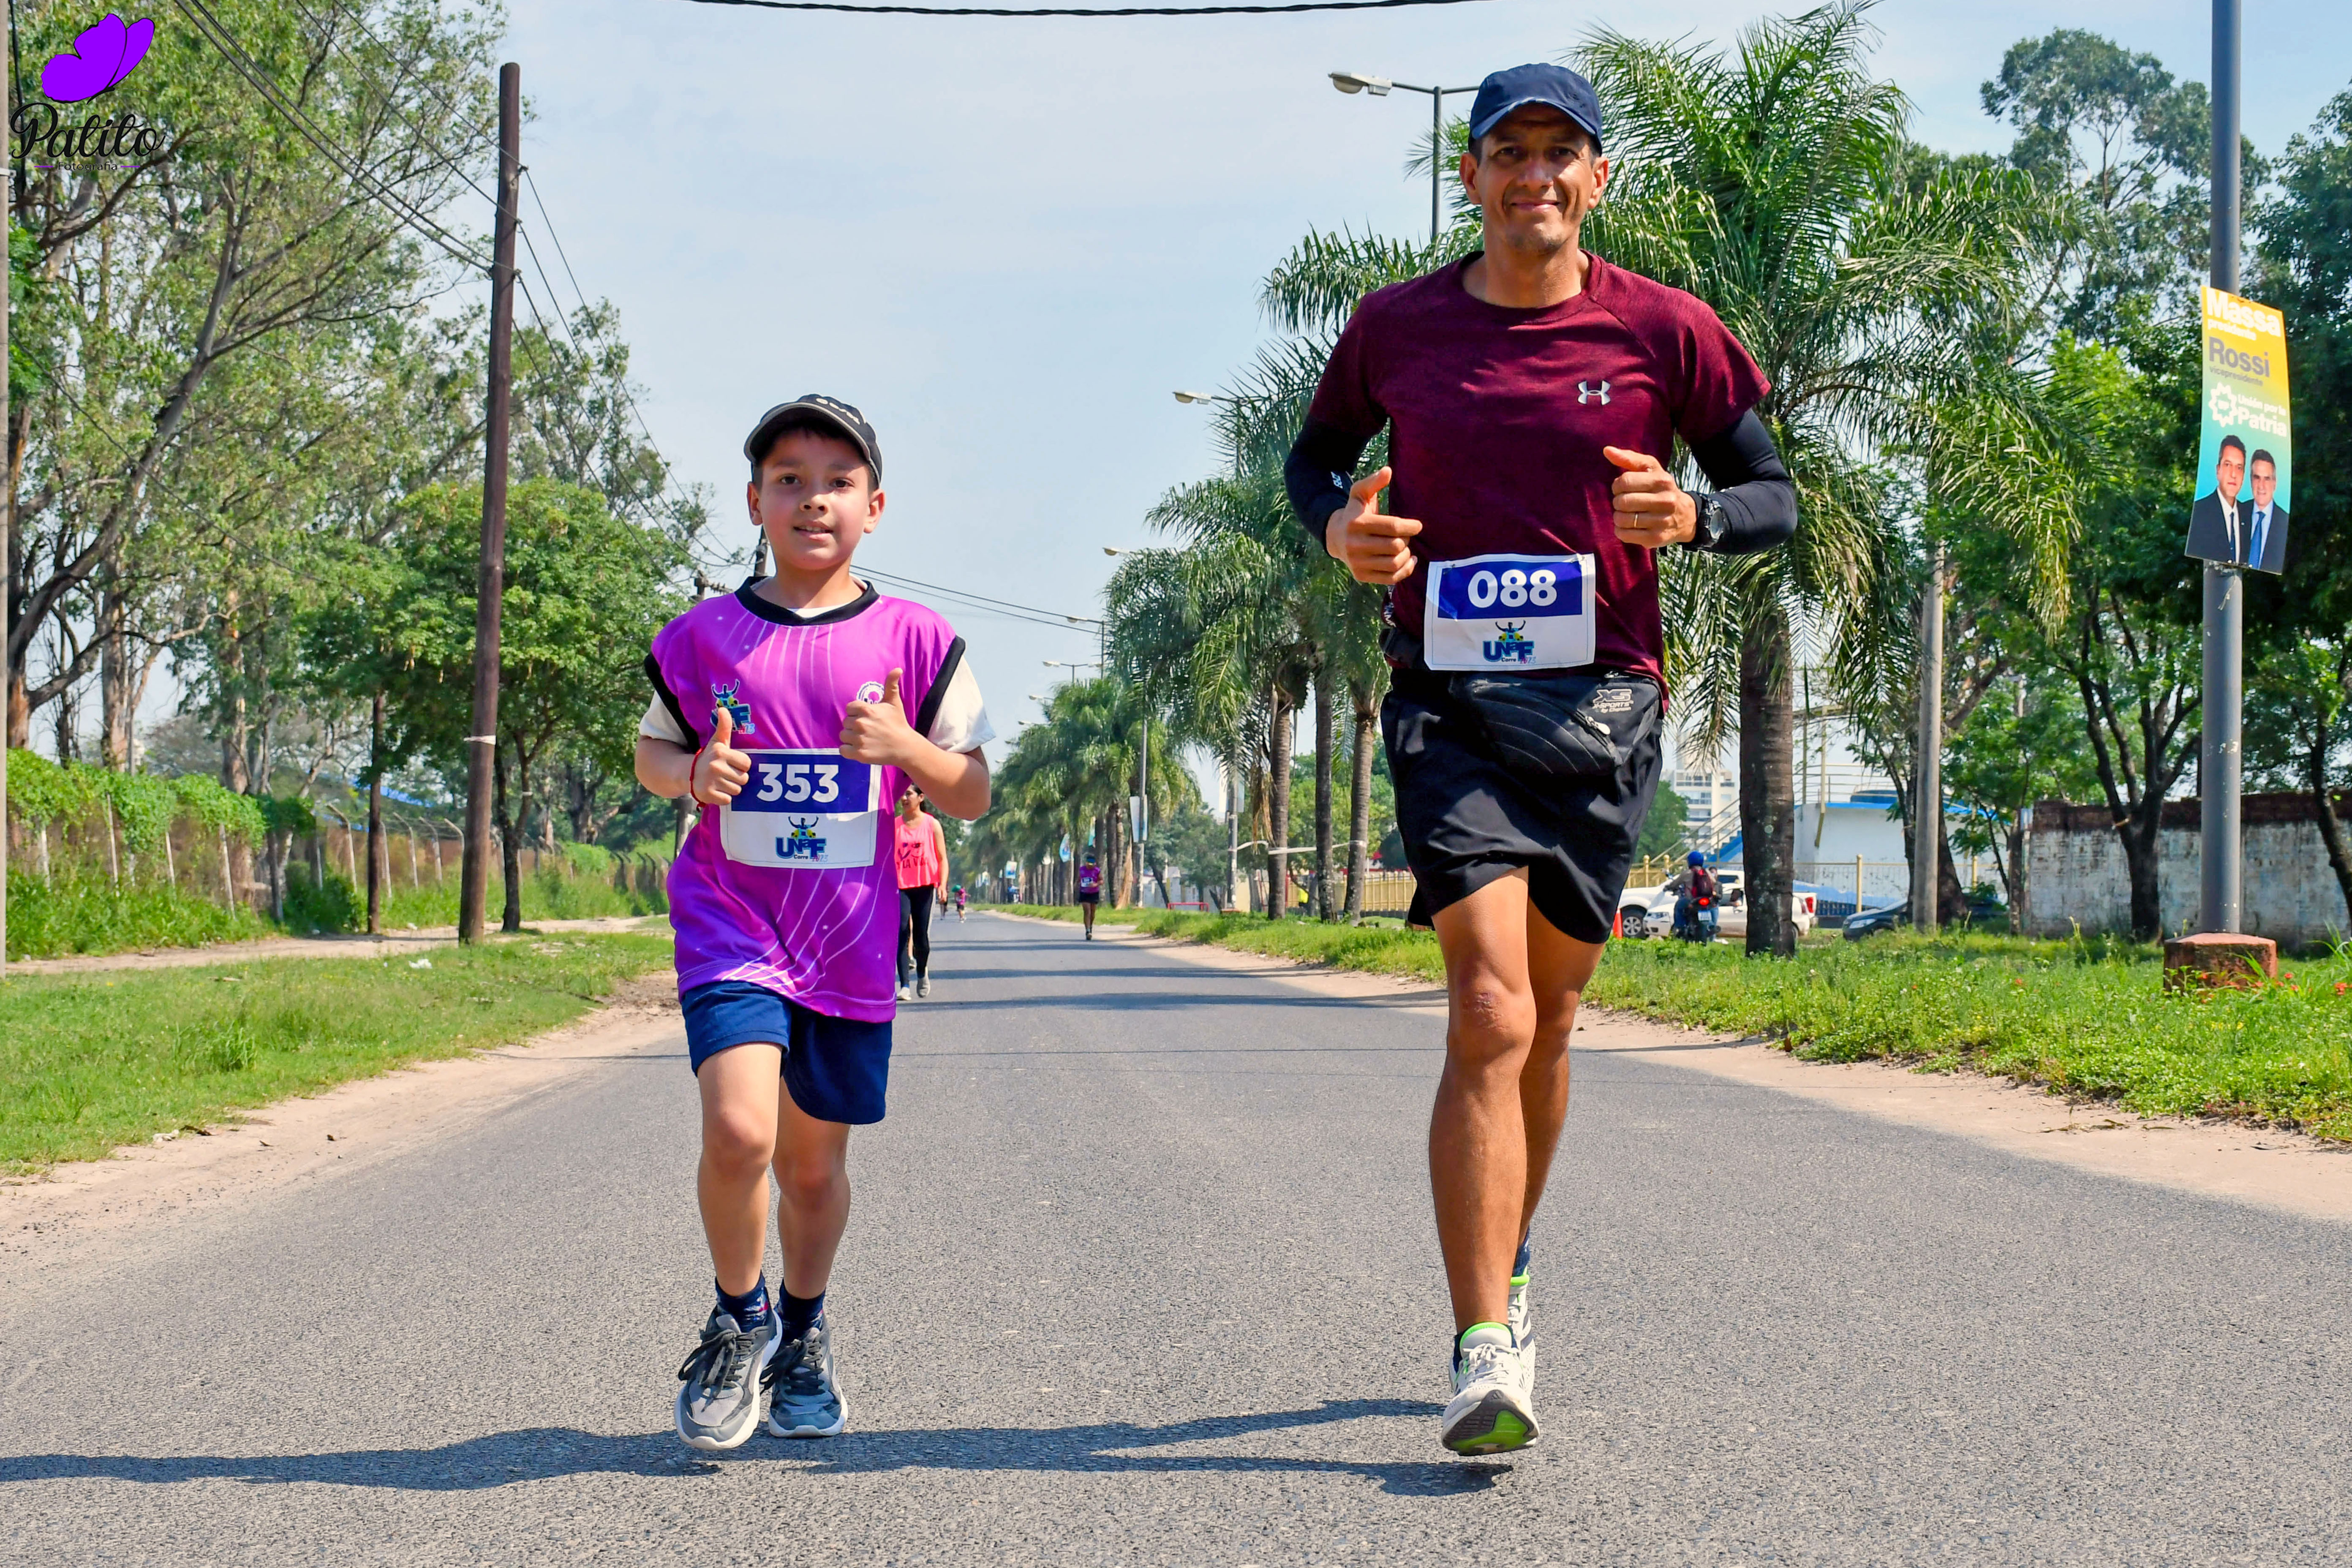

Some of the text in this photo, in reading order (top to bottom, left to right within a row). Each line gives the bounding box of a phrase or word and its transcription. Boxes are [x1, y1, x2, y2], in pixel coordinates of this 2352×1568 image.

[2206, 287, 2281, 337] Massa
[2209, 336, 2270, 377] Rossi
[2238, 407, 2287, 437] Patria
[1468, 569, 1557, 608] 088
[1593, 689, 1632, 703] XS
[757, 763, 839, 803] 353
